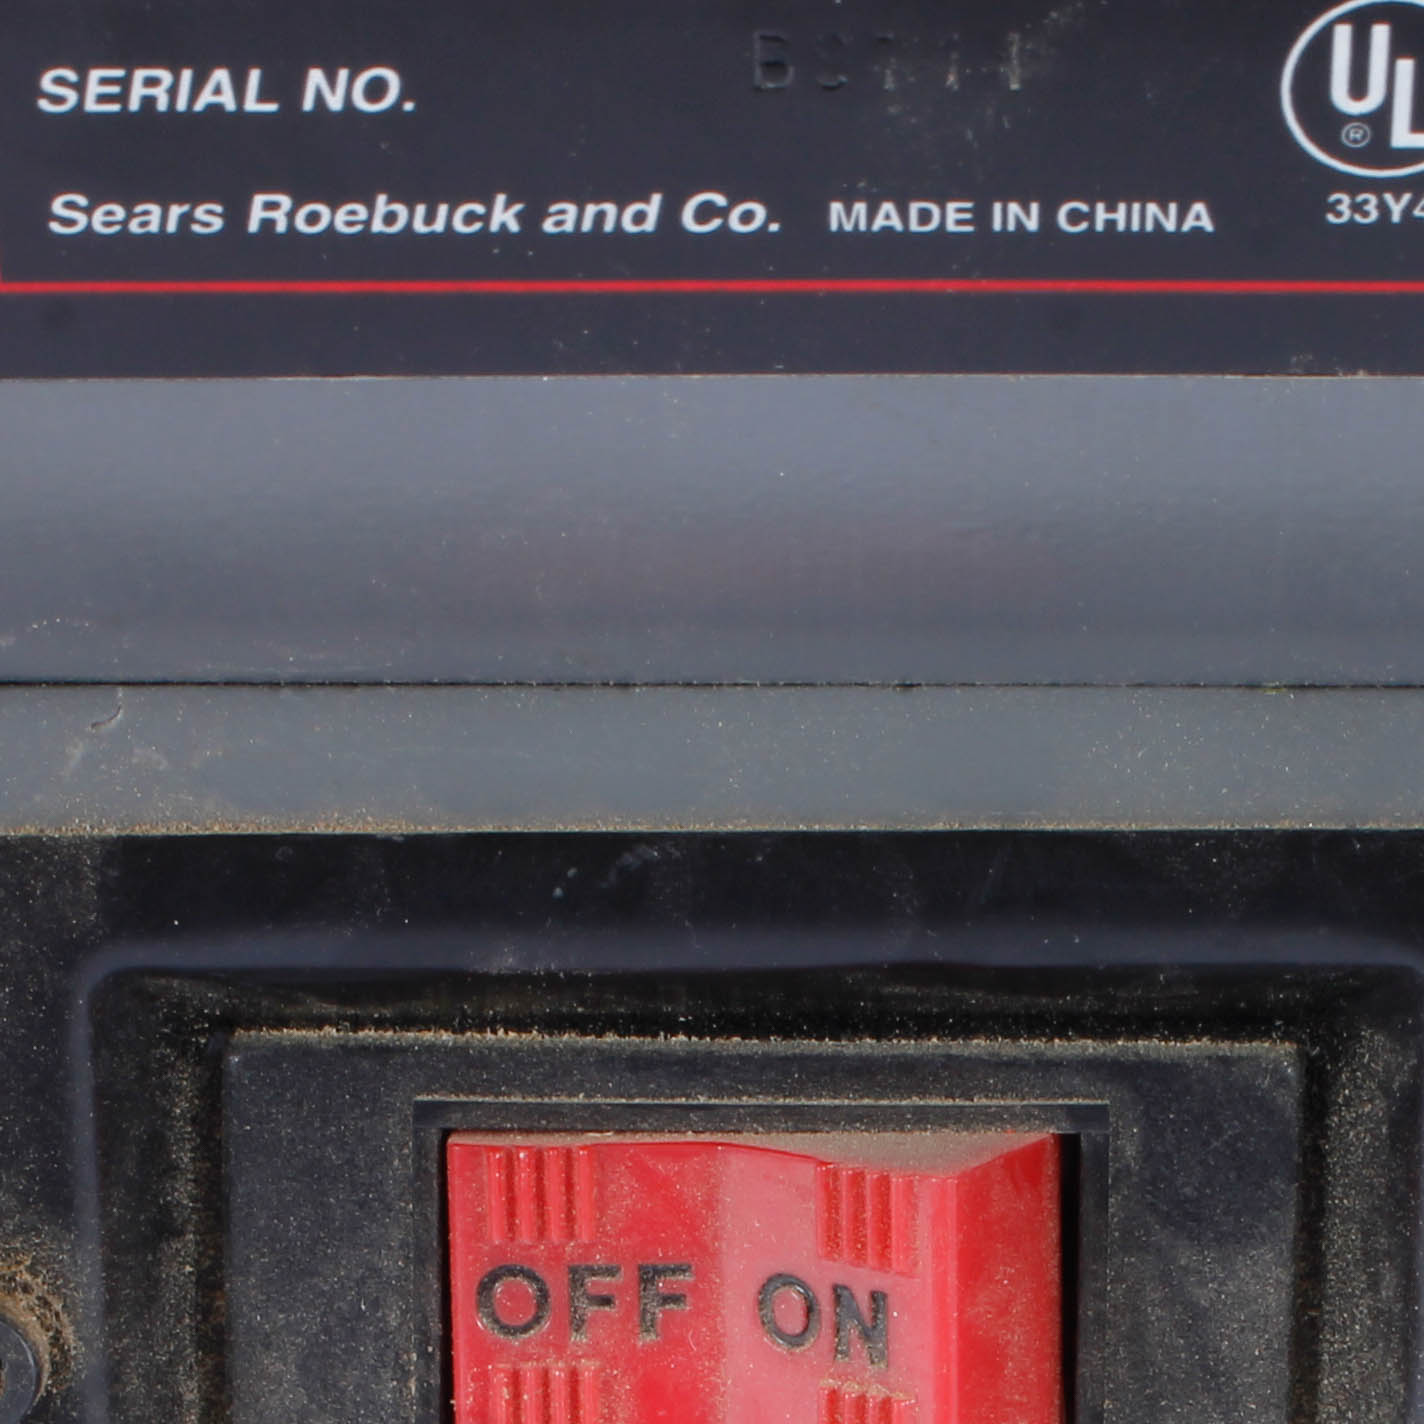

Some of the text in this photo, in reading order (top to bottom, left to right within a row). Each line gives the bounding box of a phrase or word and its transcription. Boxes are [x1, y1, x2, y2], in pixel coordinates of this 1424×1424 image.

[36, 66, 416, 113] SERIAL NO.
[48, 191, 782, 235] Sears Roebuck and Co.
[829, 201, 1215, 233] MADE IN CHINA
[475, 1261, 694, 1344] OFF
[757, 1272, 890, 1370] ON
